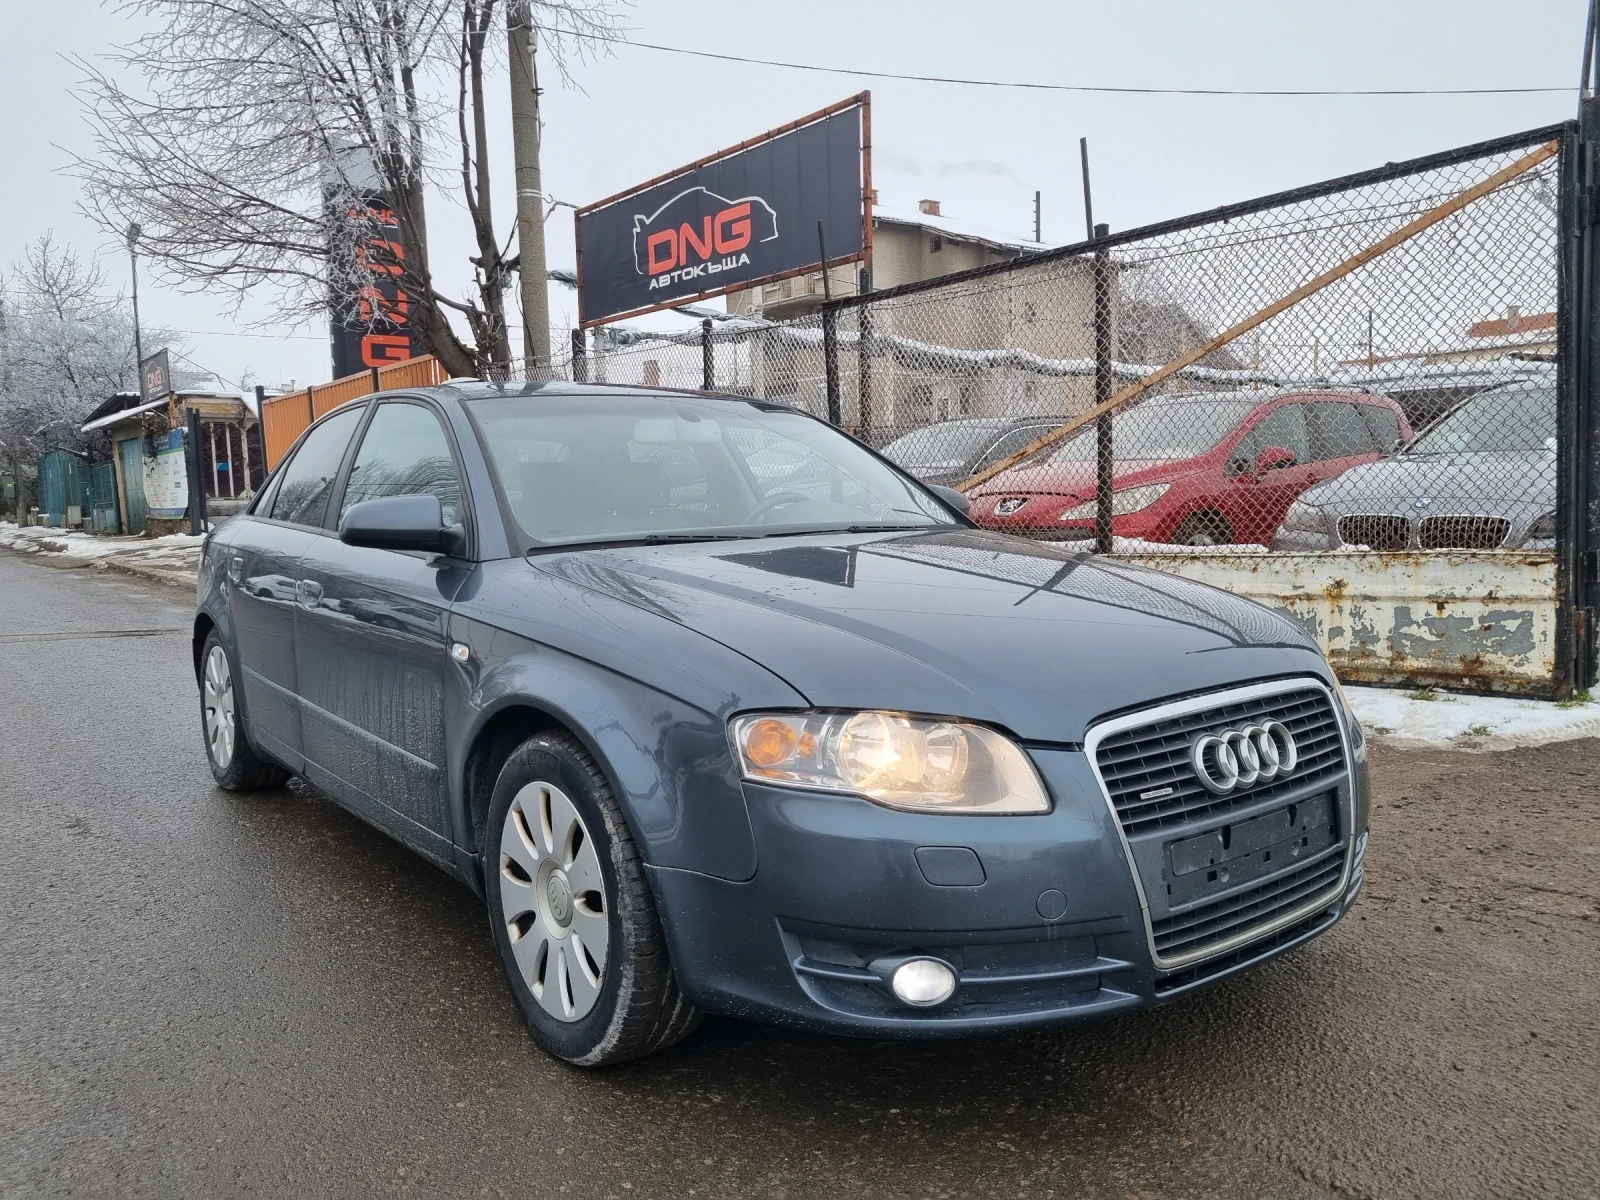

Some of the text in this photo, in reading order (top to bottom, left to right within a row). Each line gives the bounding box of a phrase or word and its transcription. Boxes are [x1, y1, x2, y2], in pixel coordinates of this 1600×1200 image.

[648, 202, 751, 276] DNG
[649, 253, 750, 290] АВТОКЪЩА
[147, 369, 162, 388] DNG
